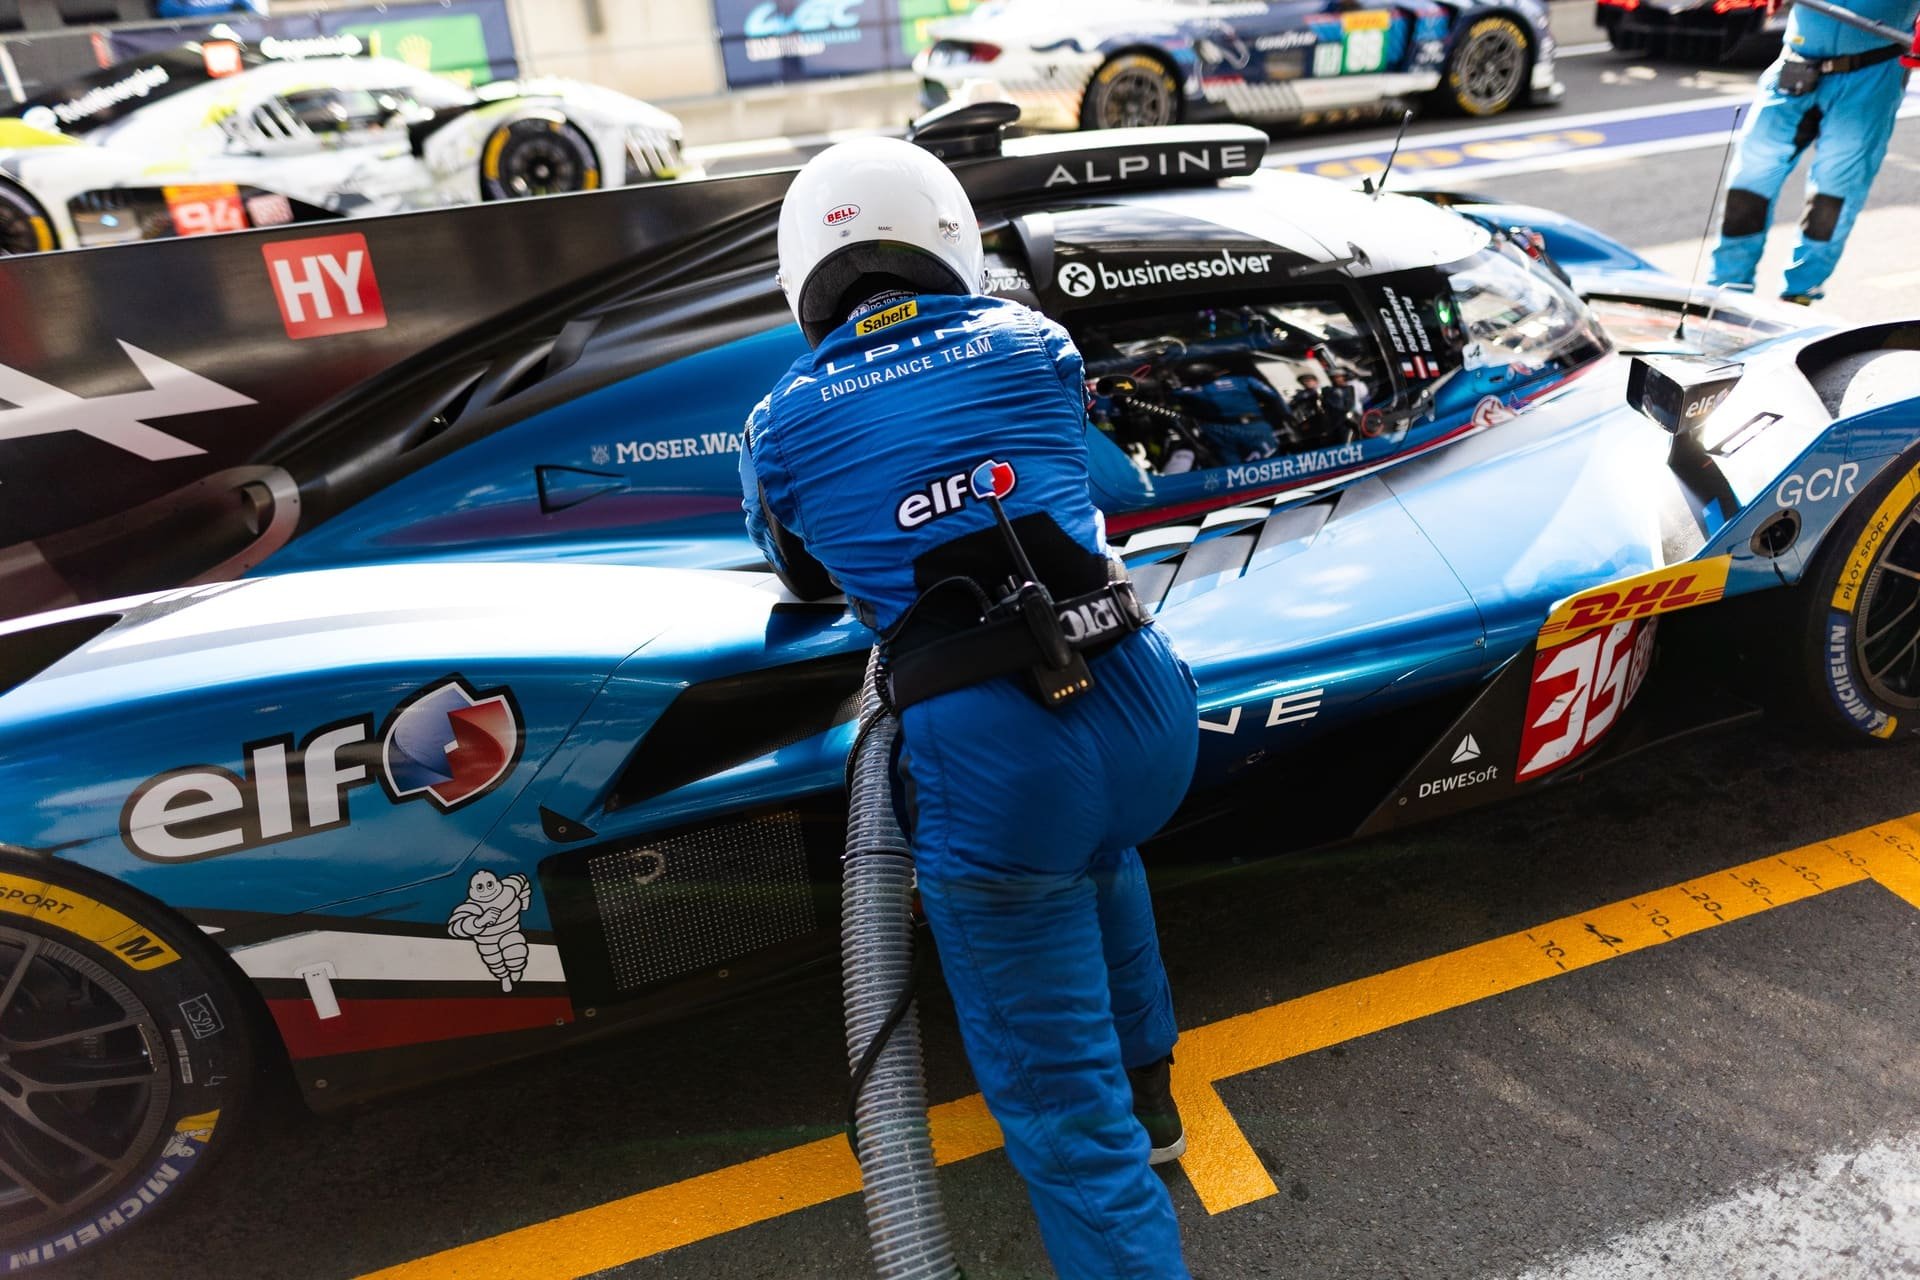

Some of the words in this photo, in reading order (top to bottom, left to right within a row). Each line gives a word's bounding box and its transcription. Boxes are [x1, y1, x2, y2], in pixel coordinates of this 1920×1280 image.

[1044, 145, 1248, 187] ALPINE
[827, 207, 856, 223] BELL
[273, 250, 364, 323] HY
[1098, 249, 1272, 290] businessolver
[862, 303, 912, 334] Sabelt
[820, 356, 935, 402] ENDURANCE
[940, 337, 993, 363] TEAM
[1686, 395, 1716, 418] elf
[1226, 444, 1363, 488] MOSER.WATCH
[1776, 463, 1859, 508] GCR
[899, 474, 967, 528] elf
[1843, 551, 1864, 600] PILOT
[1860, 511, 1890, 559] SPORT
[1564, 574, 1704, 631] DHL
[1831, 625, 1870, 721] MICHELIN
[1518, 619, 1637, 776] 35
[130, 723, 366, 857] elf
[1419, 766, 1499, 799] DEWESoft
[1690, 891, 1723, 913] 20
[114, 935, 164, 962] M
[9, 1163, 180, 1270] MICHELIN
